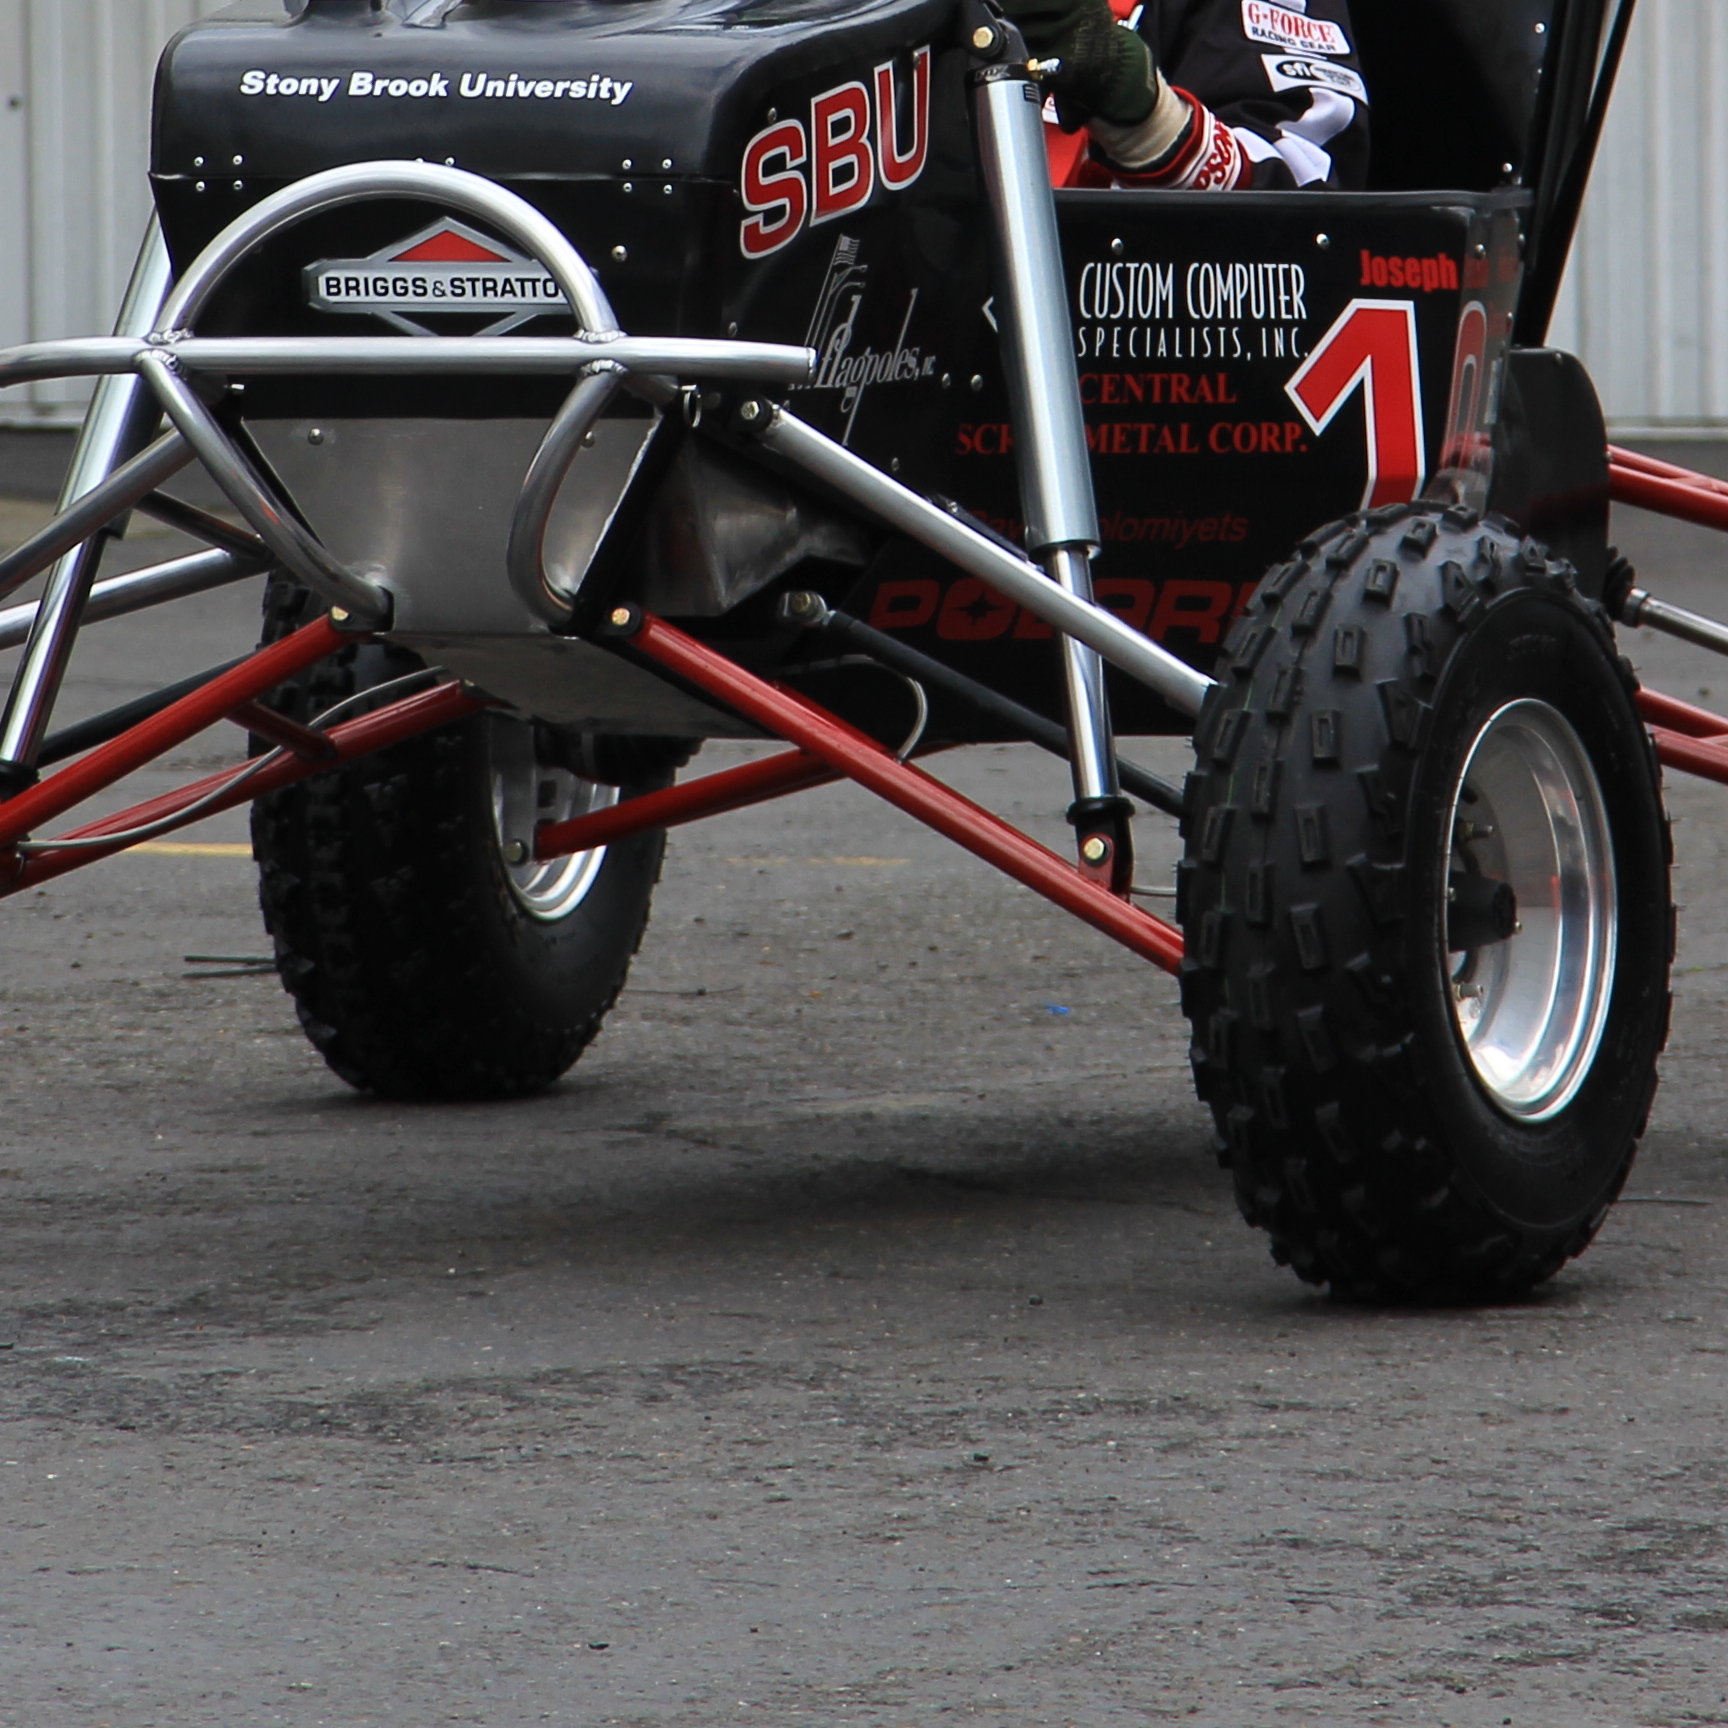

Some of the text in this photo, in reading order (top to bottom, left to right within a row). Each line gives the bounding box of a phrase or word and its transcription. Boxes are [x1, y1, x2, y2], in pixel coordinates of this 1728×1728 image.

[1247, 2, 1336, 44] G-FORCE
[1251, 25, 1337, 52] RACING GEAR
[239, 70, 634, 105] Stony Brook University
[739, 44, 933, 260] SBU
[324, 276, 560, 299] BRIGGS&STRATTO
[1359, 249, 1459, 293] Joseph
[1079, 262, 1308, 320] CUSTOM COMPUTER
[1077, 326, 1308, 361] SPECIALISTS, INC.
[1078, 373, 1239, 405] CENTRAL
[1086, 422, 1201, 454] METAL
[1208, 421, 1309, 454] CORP.
